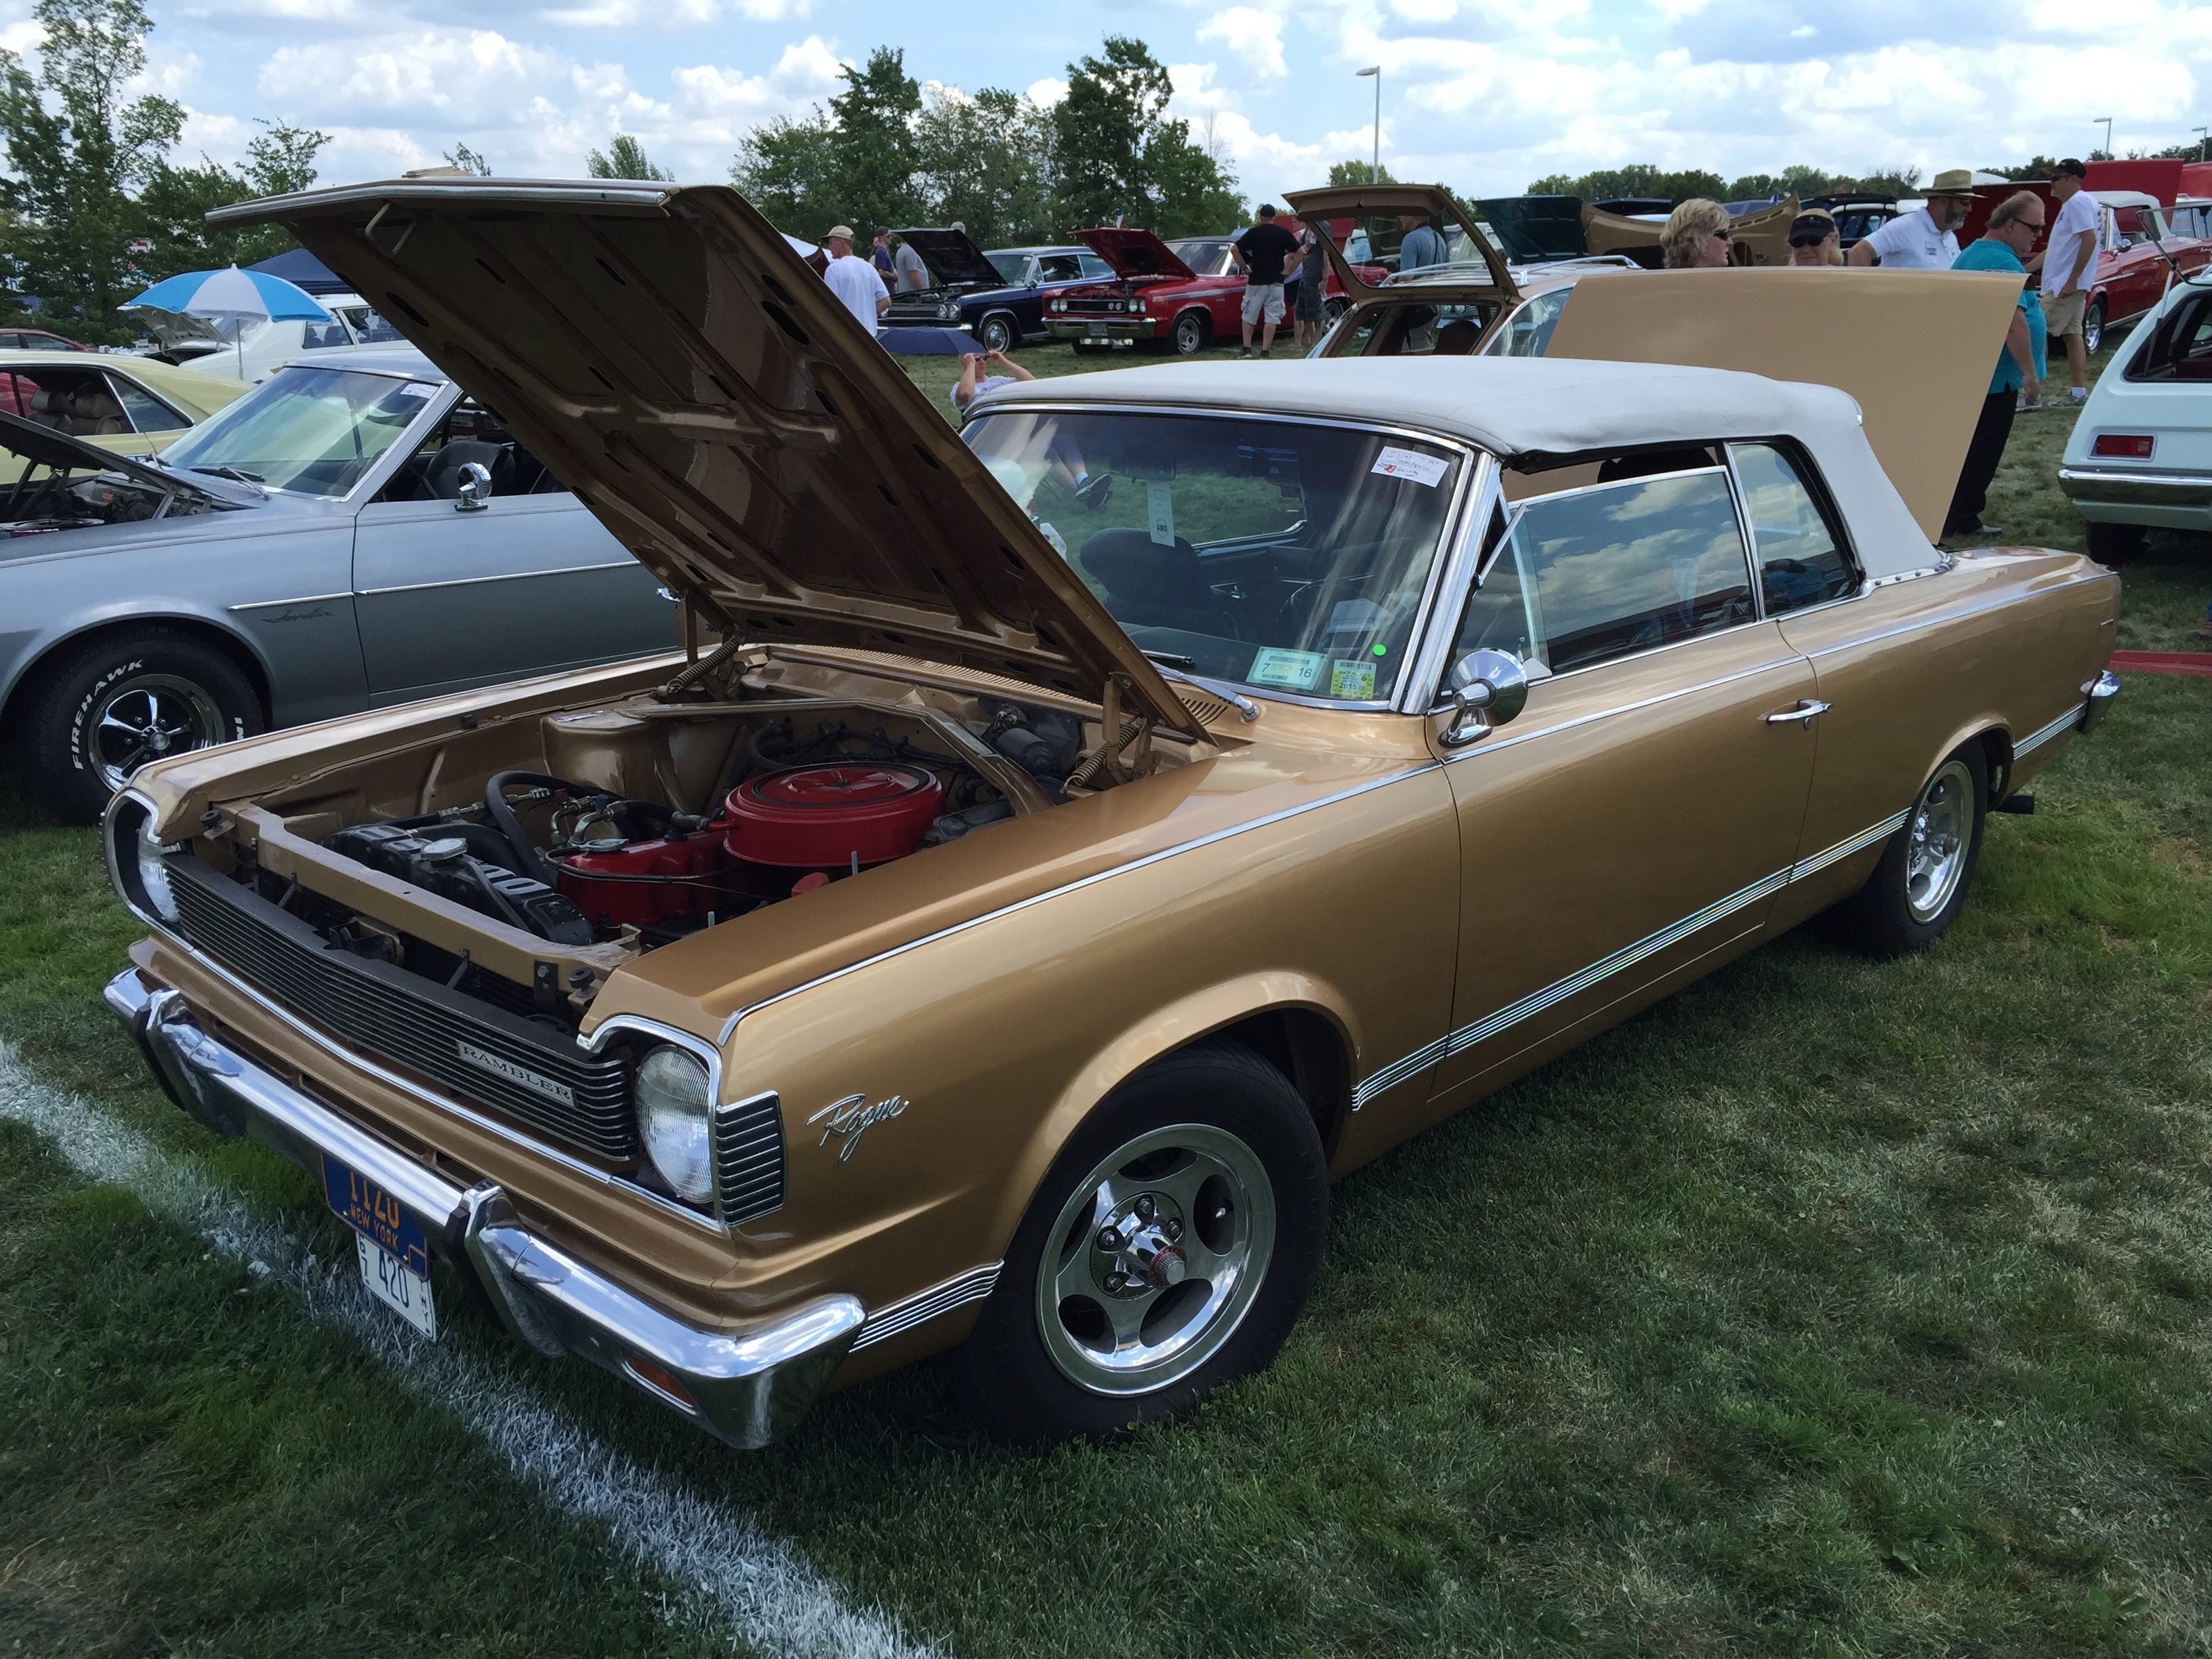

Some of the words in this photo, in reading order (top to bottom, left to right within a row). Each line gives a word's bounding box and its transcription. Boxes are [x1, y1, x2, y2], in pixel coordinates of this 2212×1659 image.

[1262, 663, 1271, 673] 7
[1298, 667, 1313, 678] 16
[1338, 682, 1357, 691] 2015
[70, 659, 143, 771] FIREHAWK
[462, 1045, 571, 1100] RAMBLER
[804, 1092, 910, 1166] Rogue
[350, 1202, 371, 1231] NEW
[373, 1220, 398, 1252] YORK
[379, 1248, 410, 1309] 420
